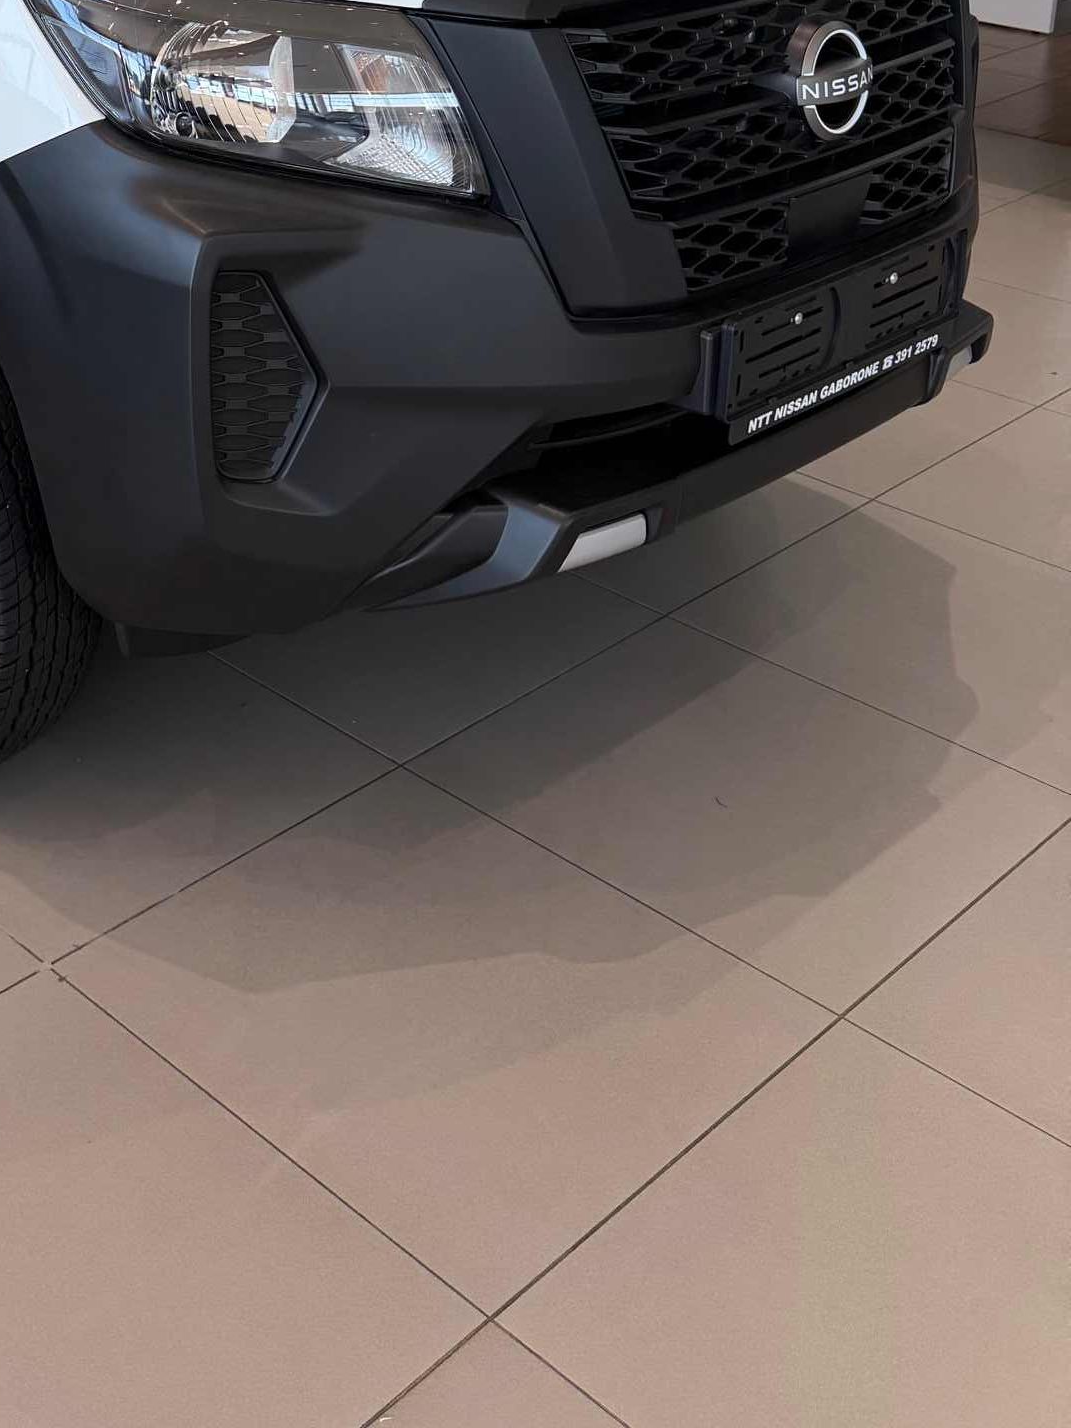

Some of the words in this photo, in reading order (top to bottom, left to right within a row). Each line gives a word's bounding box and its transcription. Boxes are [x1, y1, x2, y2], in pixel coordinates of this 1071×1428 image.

[801, 64, 874, 101] NISSAN
[748, 410, 773, 433] NTT
[774, 389, 818, 421] NISSAN
[820, 361, 880, 400] GABORONE
[894, 345, 913, 364] 391
[914, 334, 939, 356] 2579
